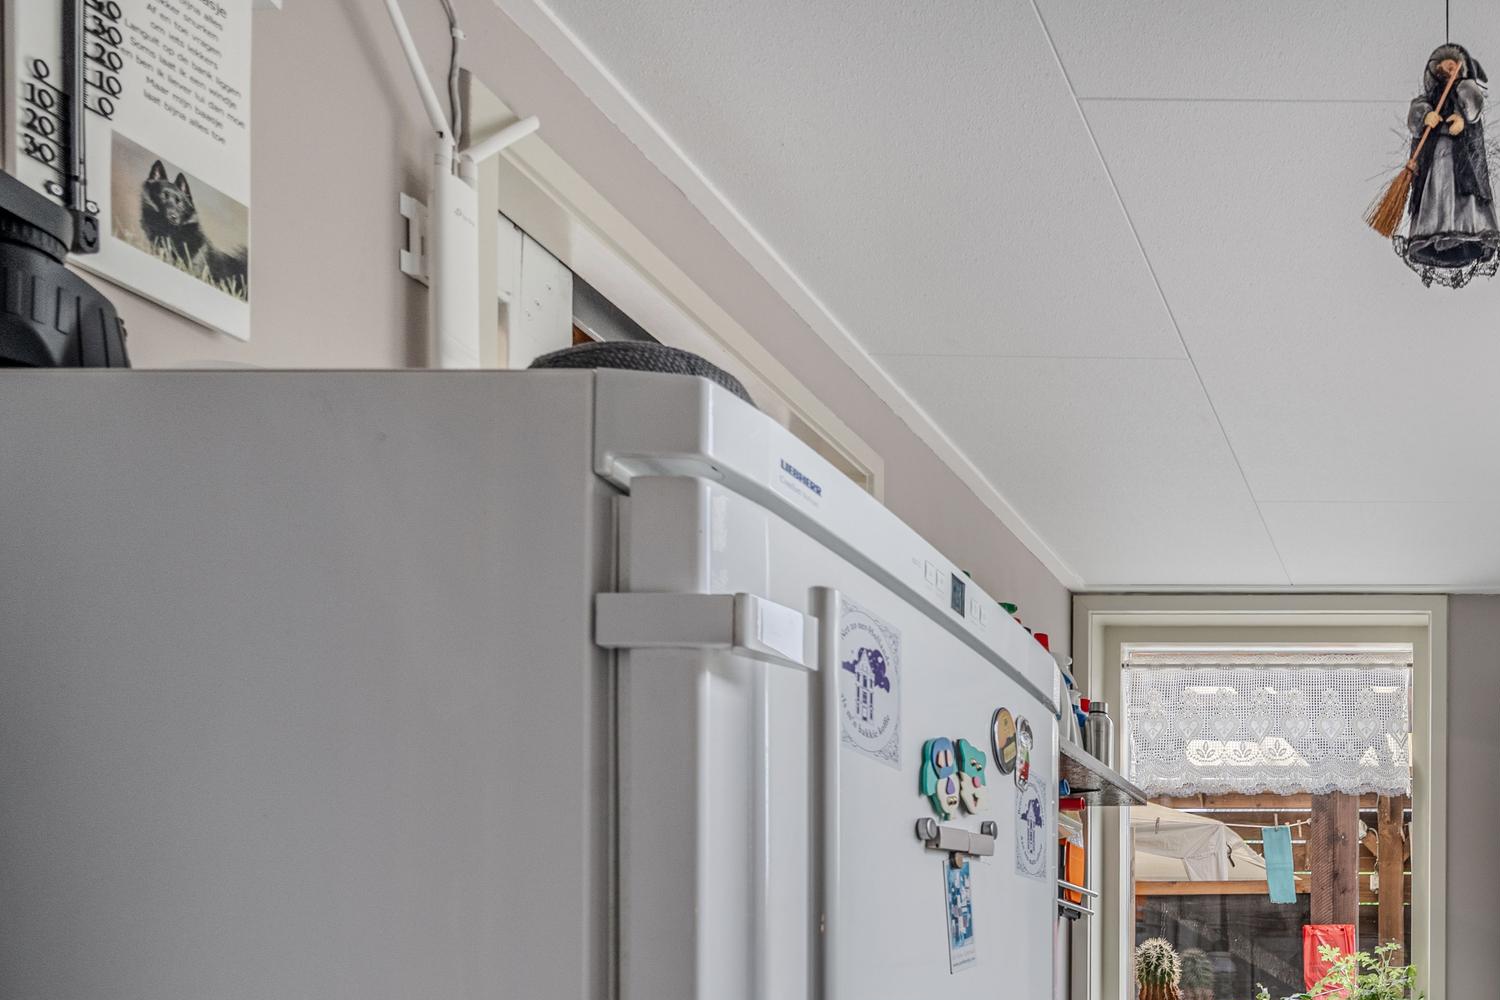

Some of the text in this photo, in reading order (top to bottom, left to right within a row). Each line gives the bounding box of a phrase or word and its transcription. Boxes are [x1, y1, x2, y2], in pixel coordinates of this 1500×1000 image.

[95, 42, 123, 73] 20
[96, 70, 122, 95] 10
[26, 83, 54, 110] 10
[26, 108, 55, 136] 20
